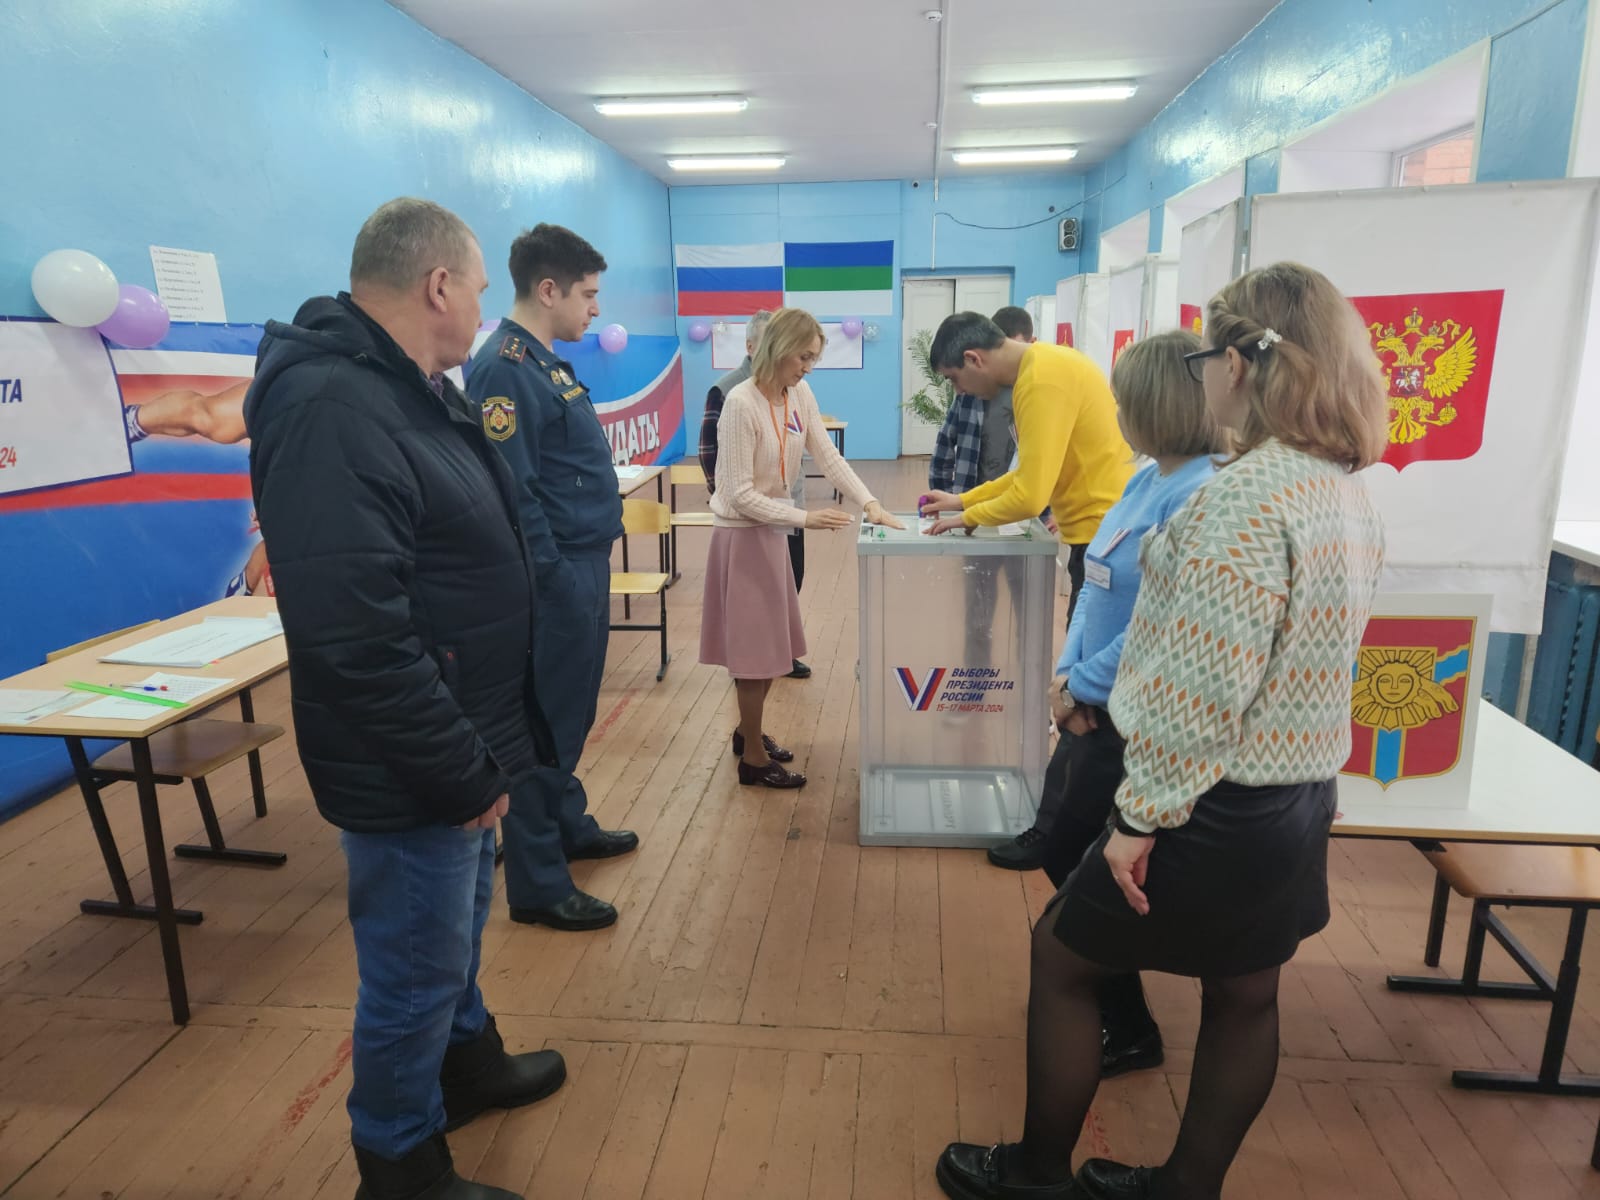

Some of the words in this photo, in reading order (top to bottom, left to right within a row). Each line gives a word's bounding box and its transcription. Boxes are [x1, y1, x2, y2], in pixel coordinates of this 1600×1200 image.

[952, 668, 1000, 678] ВЫБОРЫ
[946, 680, 1014, 691] ПРЕЗИДЕНТА
[940, 692, 984, 702] РОССИИ
[957, 704, 984, 713] МАРТА
[985, 704, 1004, 713] 2024
